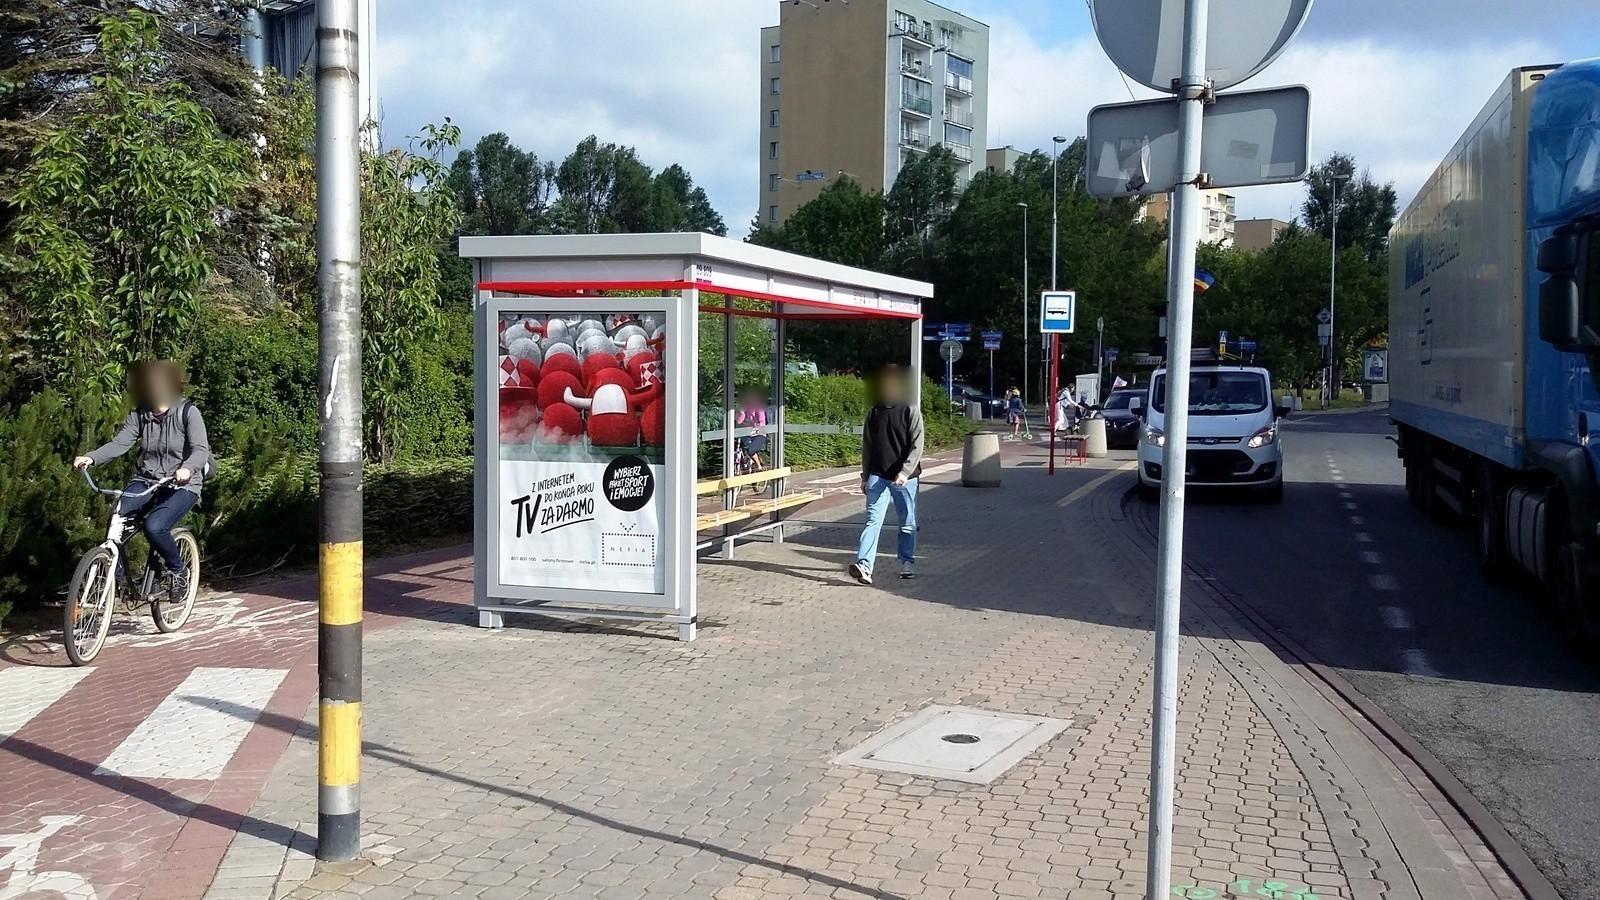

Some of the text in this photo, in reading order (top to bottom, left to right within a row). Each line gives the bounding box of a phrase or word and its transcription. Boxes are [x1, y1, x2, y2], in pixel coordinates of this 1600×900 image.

[532, 472, 574, 493] Z INTERNETEM
[624, 475, 649, 488] SPORT
[544, 492, 553, 503] DO
[577, 482, 594, 496] ROKU
[614, 486, 644, 500] EMOCJE!
[511, 493, 594, 538] TV ZA DARMO
